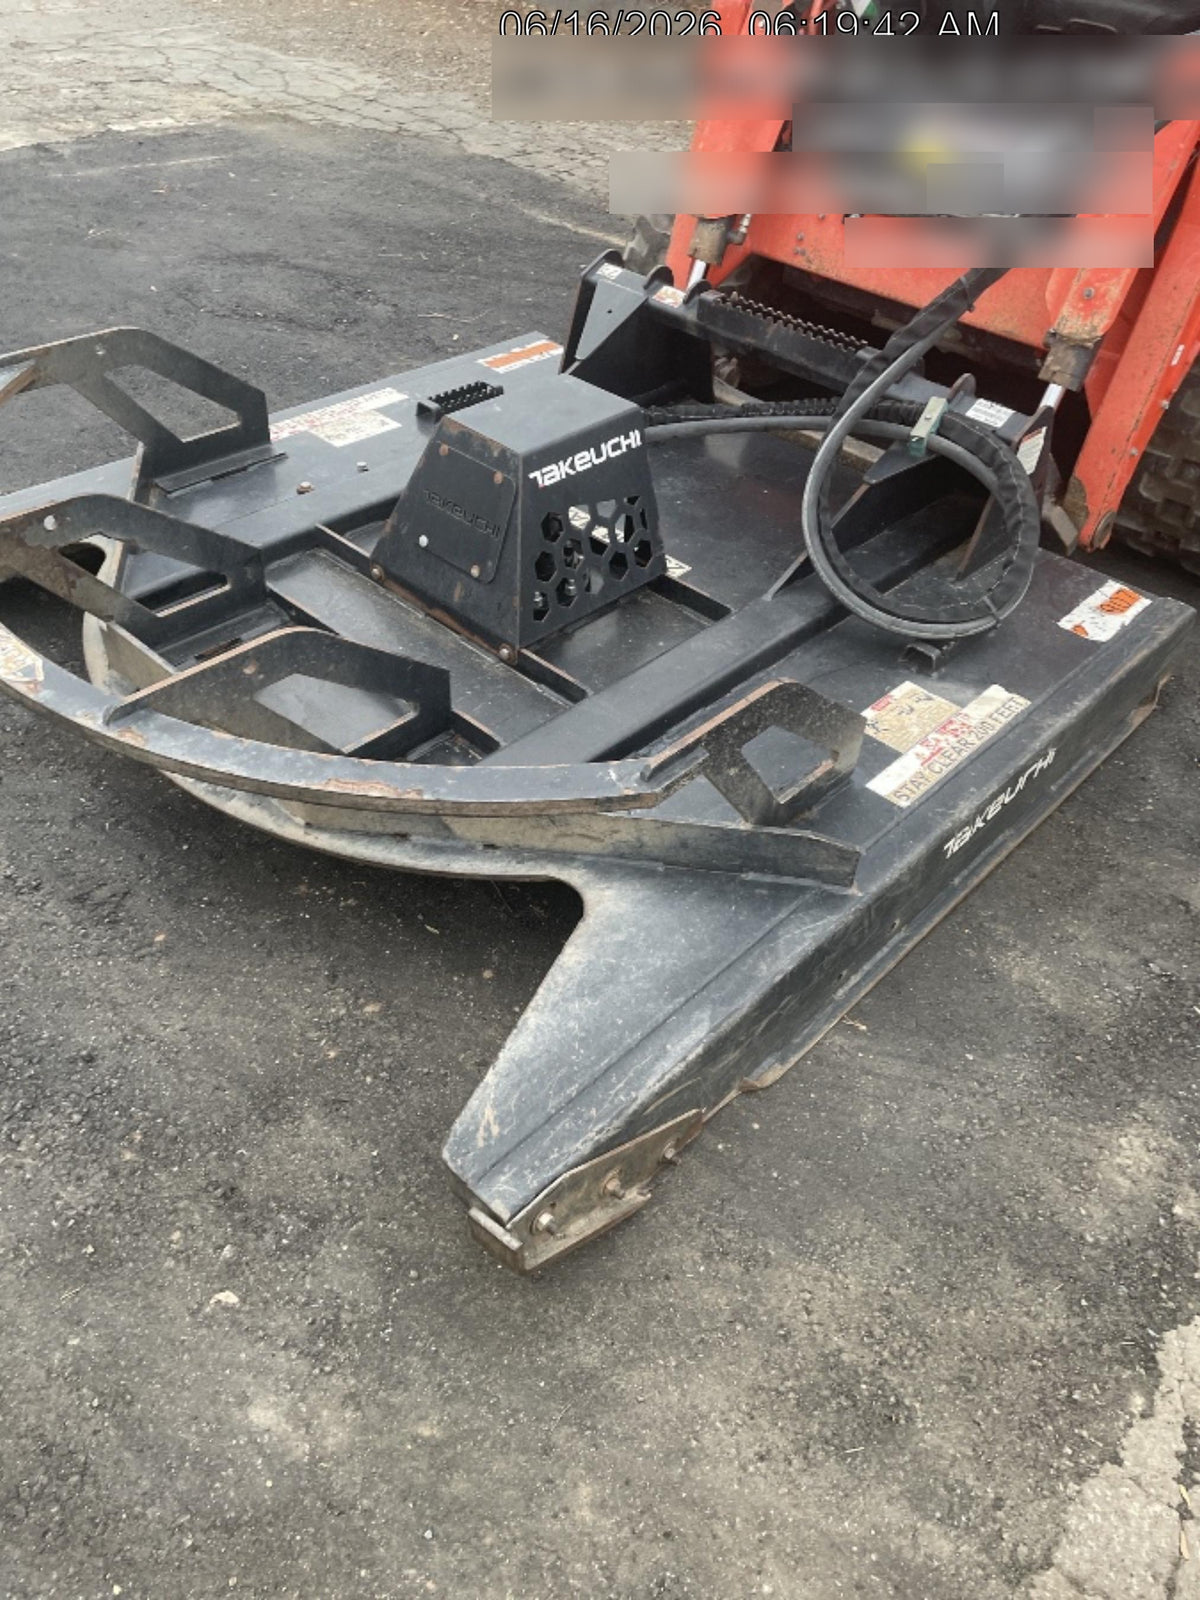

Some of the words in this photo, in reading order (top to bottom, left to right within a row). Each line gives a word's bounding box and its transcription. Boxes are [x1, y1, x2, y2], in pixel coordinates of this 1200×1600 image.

[529, 430, 642, 487] TAKEUCHI
[893, 770, 930, 803] STAY
[928, 738, 976, 775] CLEAR
[971, 720, 997, 743] 200
